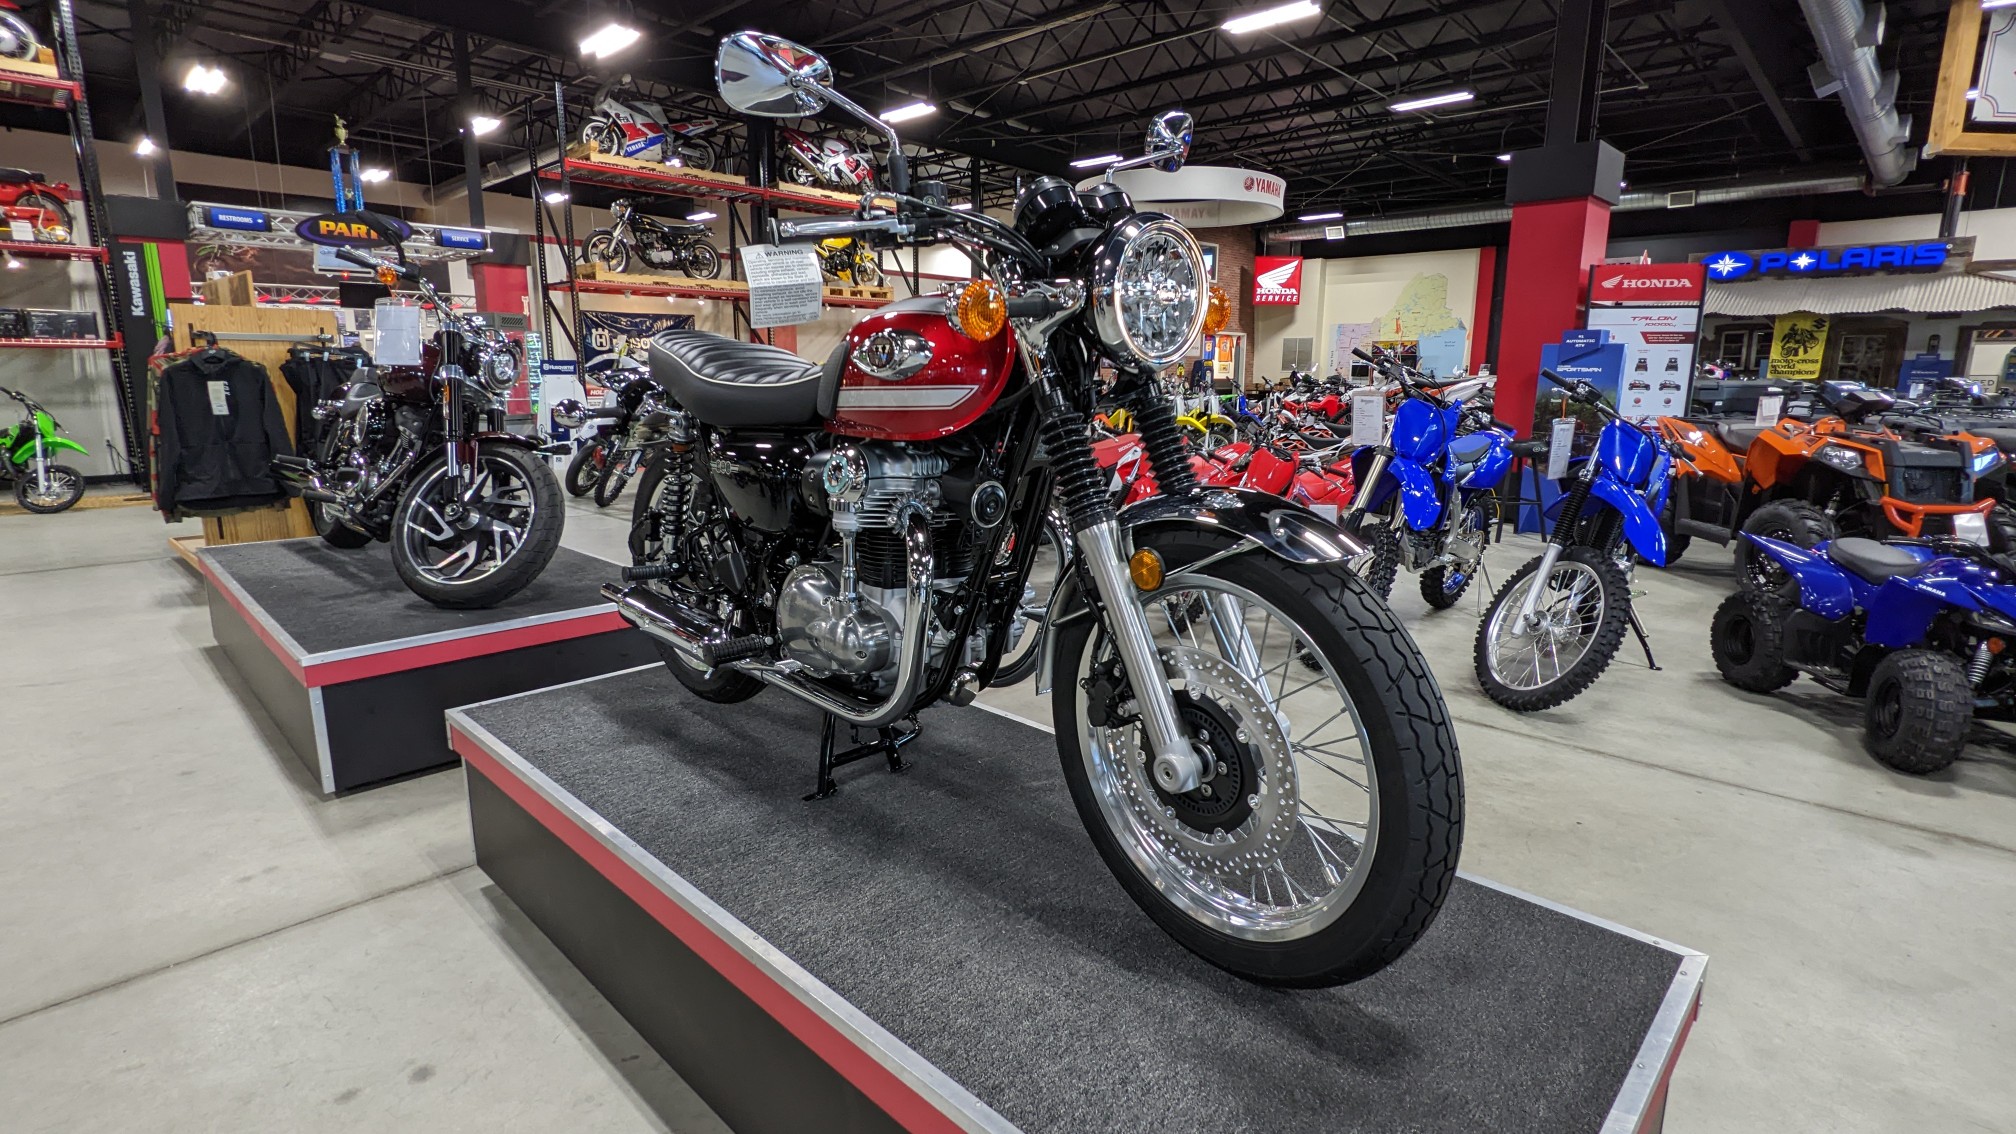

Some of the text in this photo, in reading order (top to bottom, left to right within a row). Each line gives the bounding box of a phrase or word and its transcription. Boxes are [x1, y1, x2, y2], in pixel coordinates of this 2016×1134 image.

[1255, 177, 1281, 198] YAMAHA
[218, 214, 254, 224] RESTROOMS
[1759, 243, 1948, 273] POLARIS
[123, 251, 145, 316] Kawasaki
[1622, 279, 1692, 288] HONDA
[1256, 287, 1298, 295] HONDA
[1918, 583, 1946, 597] YAMAHA
